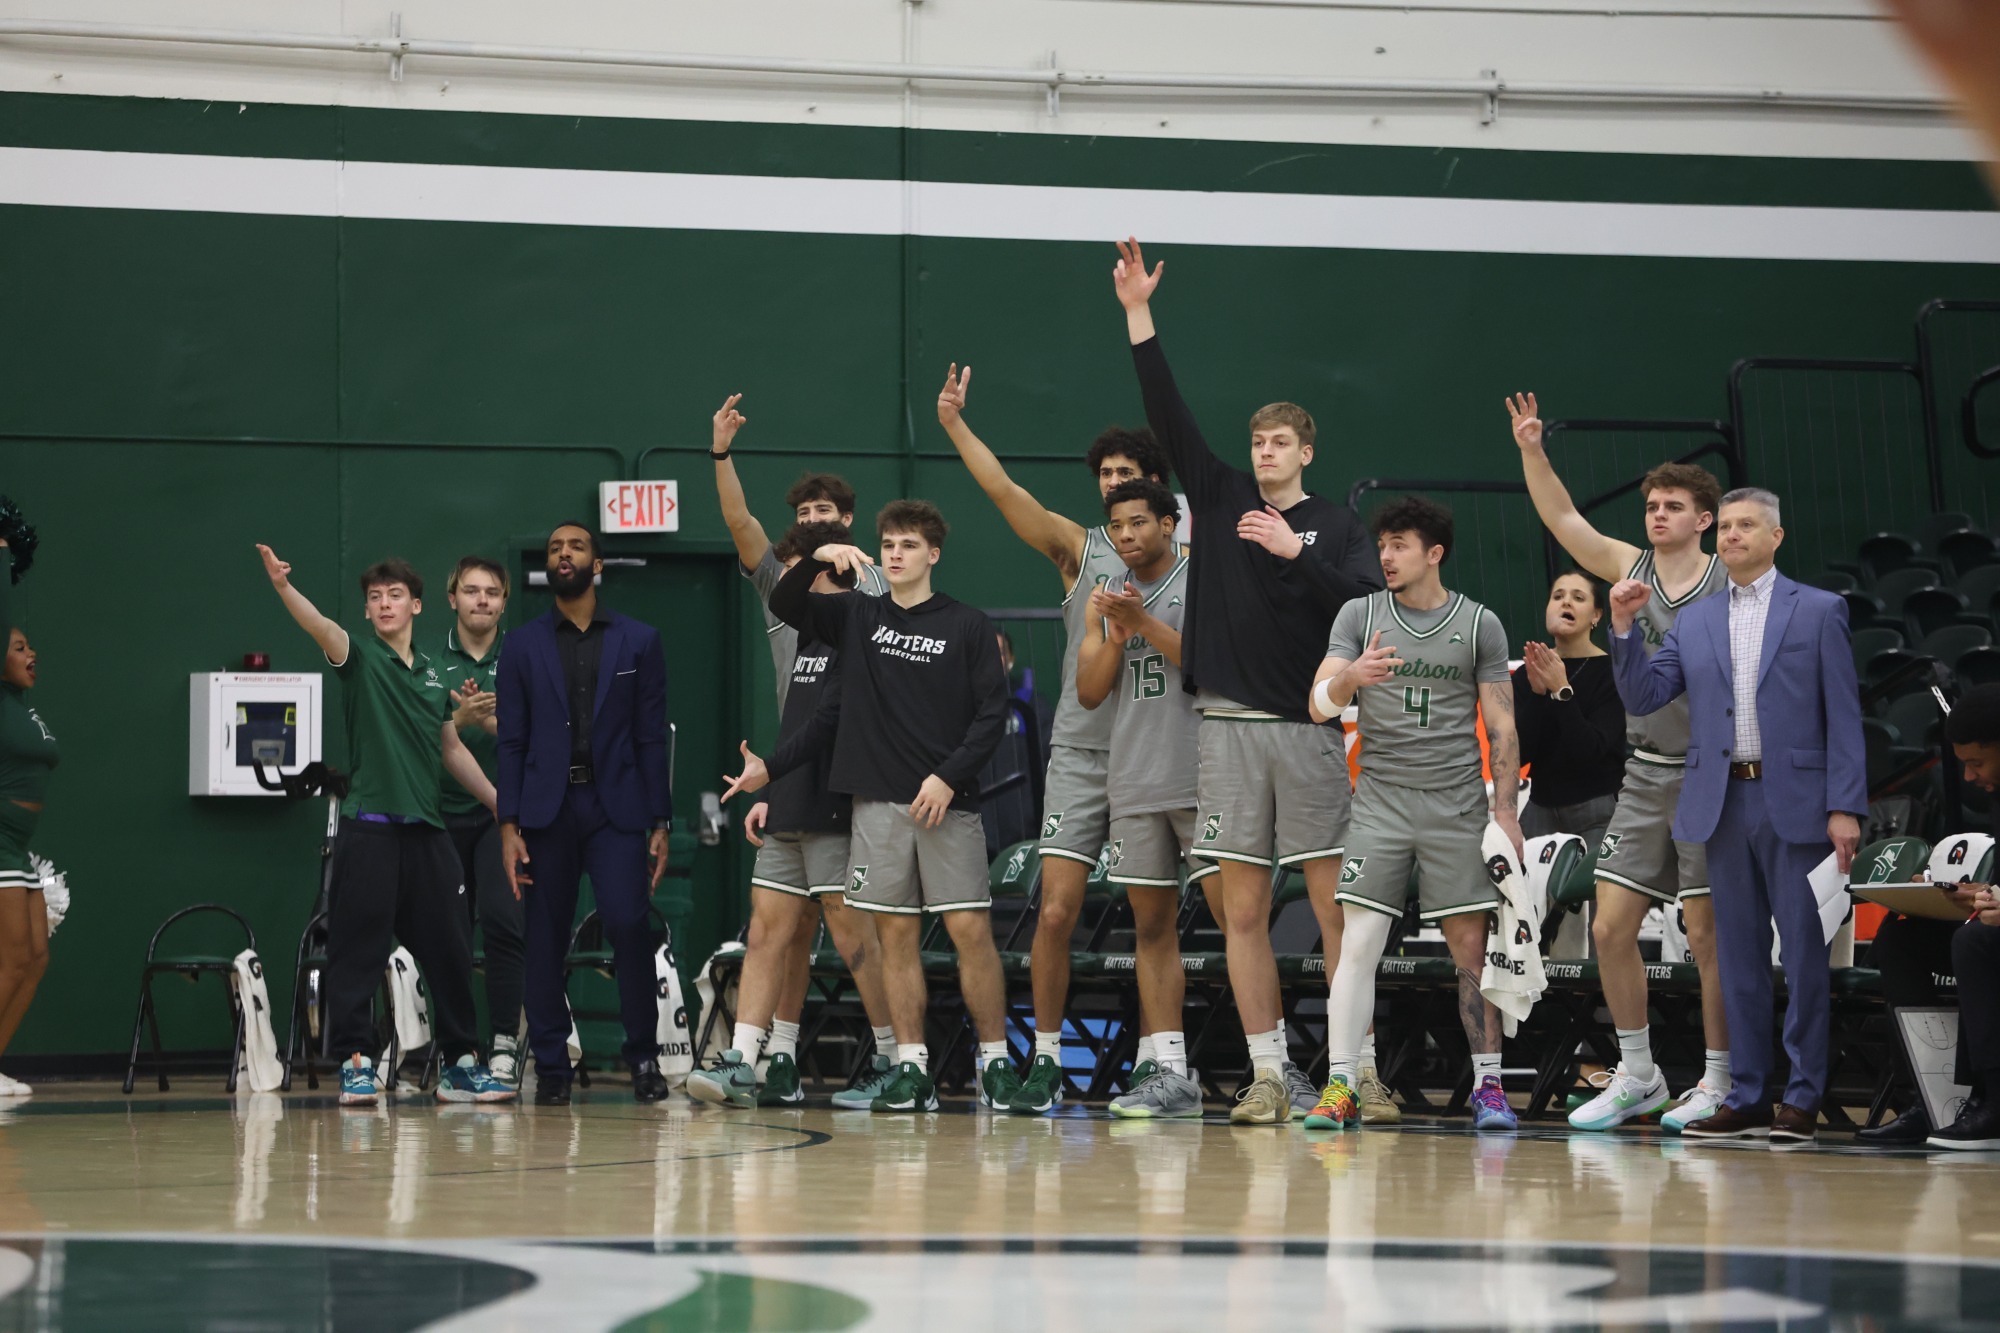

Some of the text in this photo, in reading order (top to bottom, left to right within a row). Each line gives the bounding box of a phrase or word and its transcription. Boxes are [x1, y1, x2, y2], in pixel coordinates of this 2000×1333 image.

[619, 484, 667, 526] EXIT
[871, 625, 946, 655] HATTERS
[1129, 653, 1167, 701] 15
[1403, 686, 1431, 728] 4
[1104, 956, 1136, 970] HATTERS
[1382, 959, 1416, 974] HATTERS
[1544, 963, 1583, 978] HATTERS
[1643, 965, 1673, 979] TTERS
